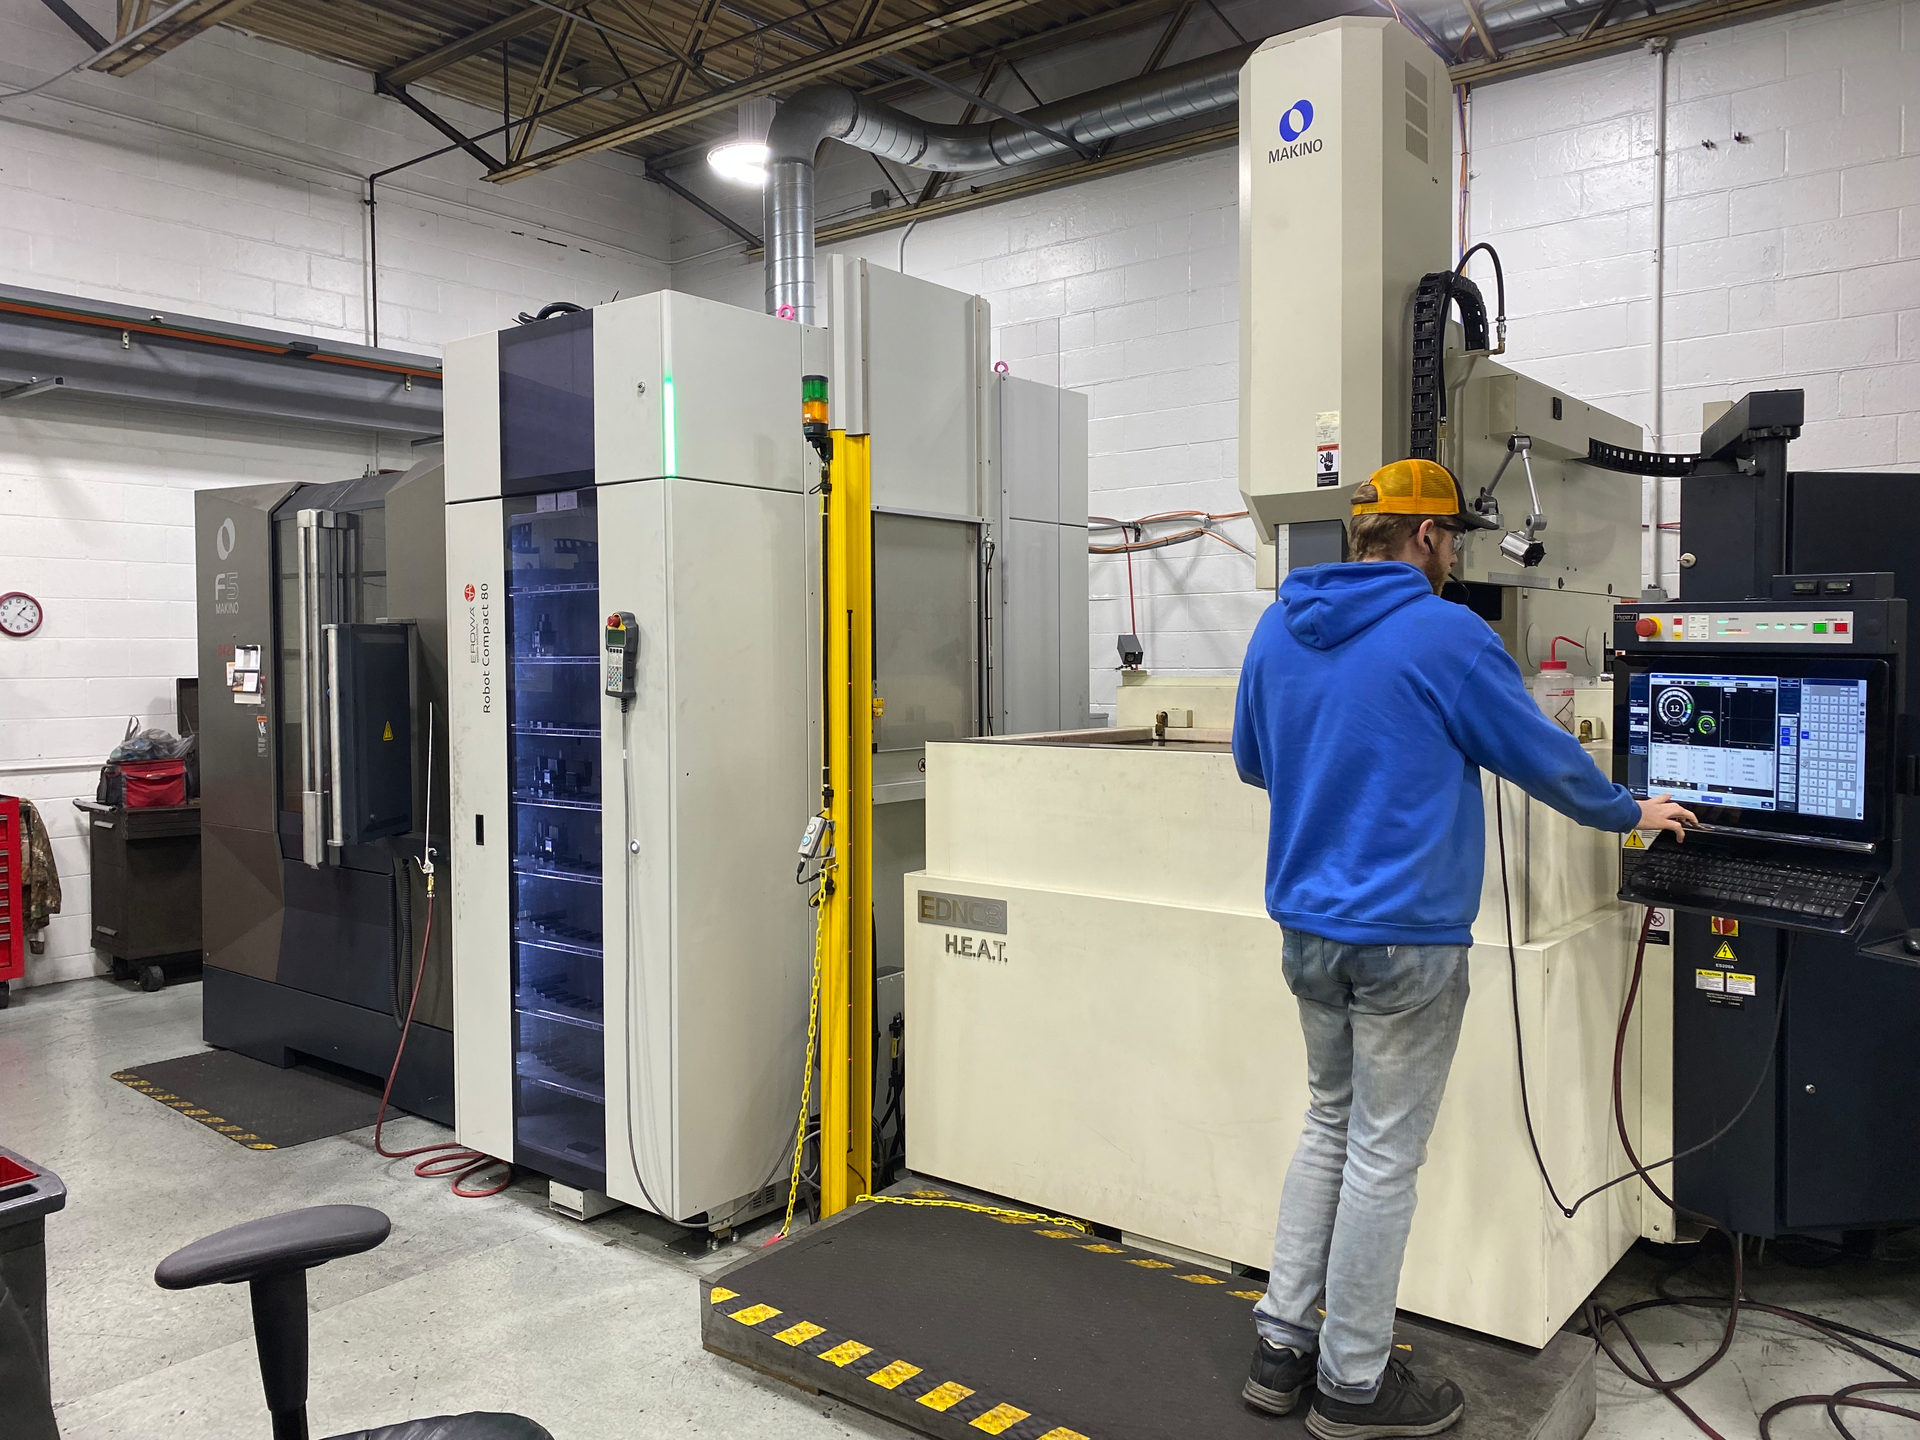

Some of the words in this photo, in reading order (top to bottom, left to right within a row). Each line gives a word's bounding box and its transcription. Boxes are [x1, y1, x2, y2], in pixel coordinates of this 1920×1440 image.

[1268, 138, 1323, 164] MAKINO
[215, 572, 239, 601] F5
[480, 583, 489, 600] 80
[215, 602, 239, 615] MAKINO
[481, 604, 491, 667] Compact
[482, 670, 491, 713] Robot
[921, 895, 1002, 928] EDNC8
[945, 933, 1008, 963] H.E.A.T.
